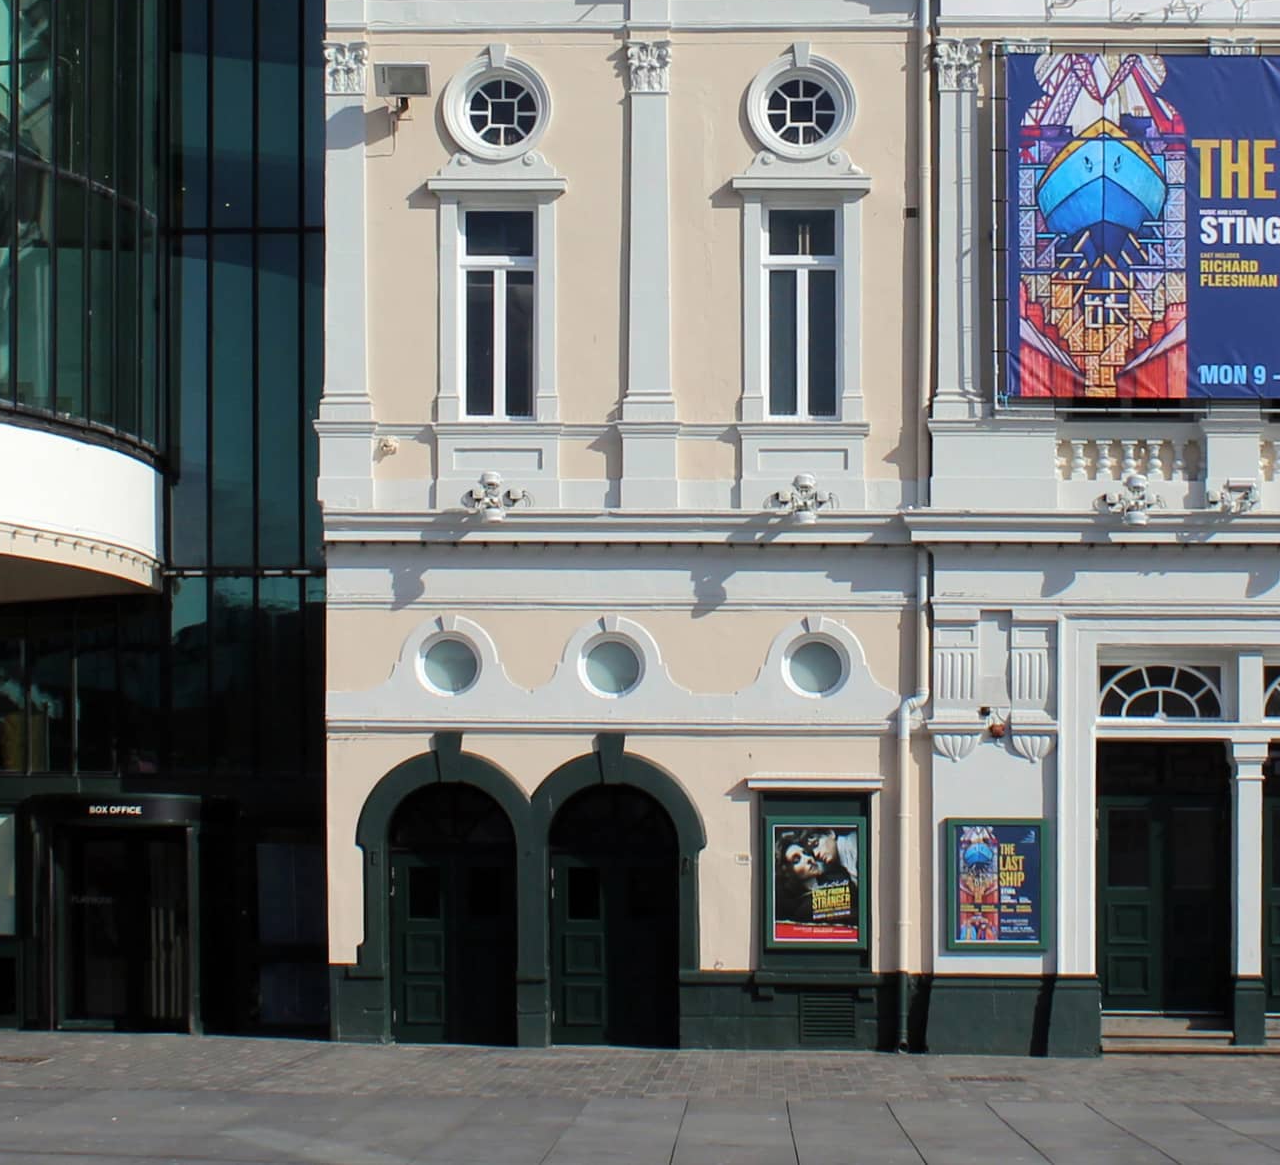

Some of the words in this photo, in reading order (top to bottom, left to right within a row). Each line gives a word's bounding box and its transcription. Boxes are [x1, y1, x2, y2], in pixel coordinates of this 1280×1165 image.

[1191, 139, 1276, 199] THE
[1200, 260, 1259, 273] RICHARD
[1200, 274, 1278, 287] FLEESHMAN
[1200, 365, 1247, 384] MON
[1253, 365, 1266, 384] 9
[89, 806, 108, 814] BOX
[109, 806, 142, 814] OFFICE
[1000, 843, 1015, 855] THE
[1000, 856, 1024, 870] LAST
[1000, 872, 1024, 887] SHIP
[812, 894, 851, 910] STRANGER
